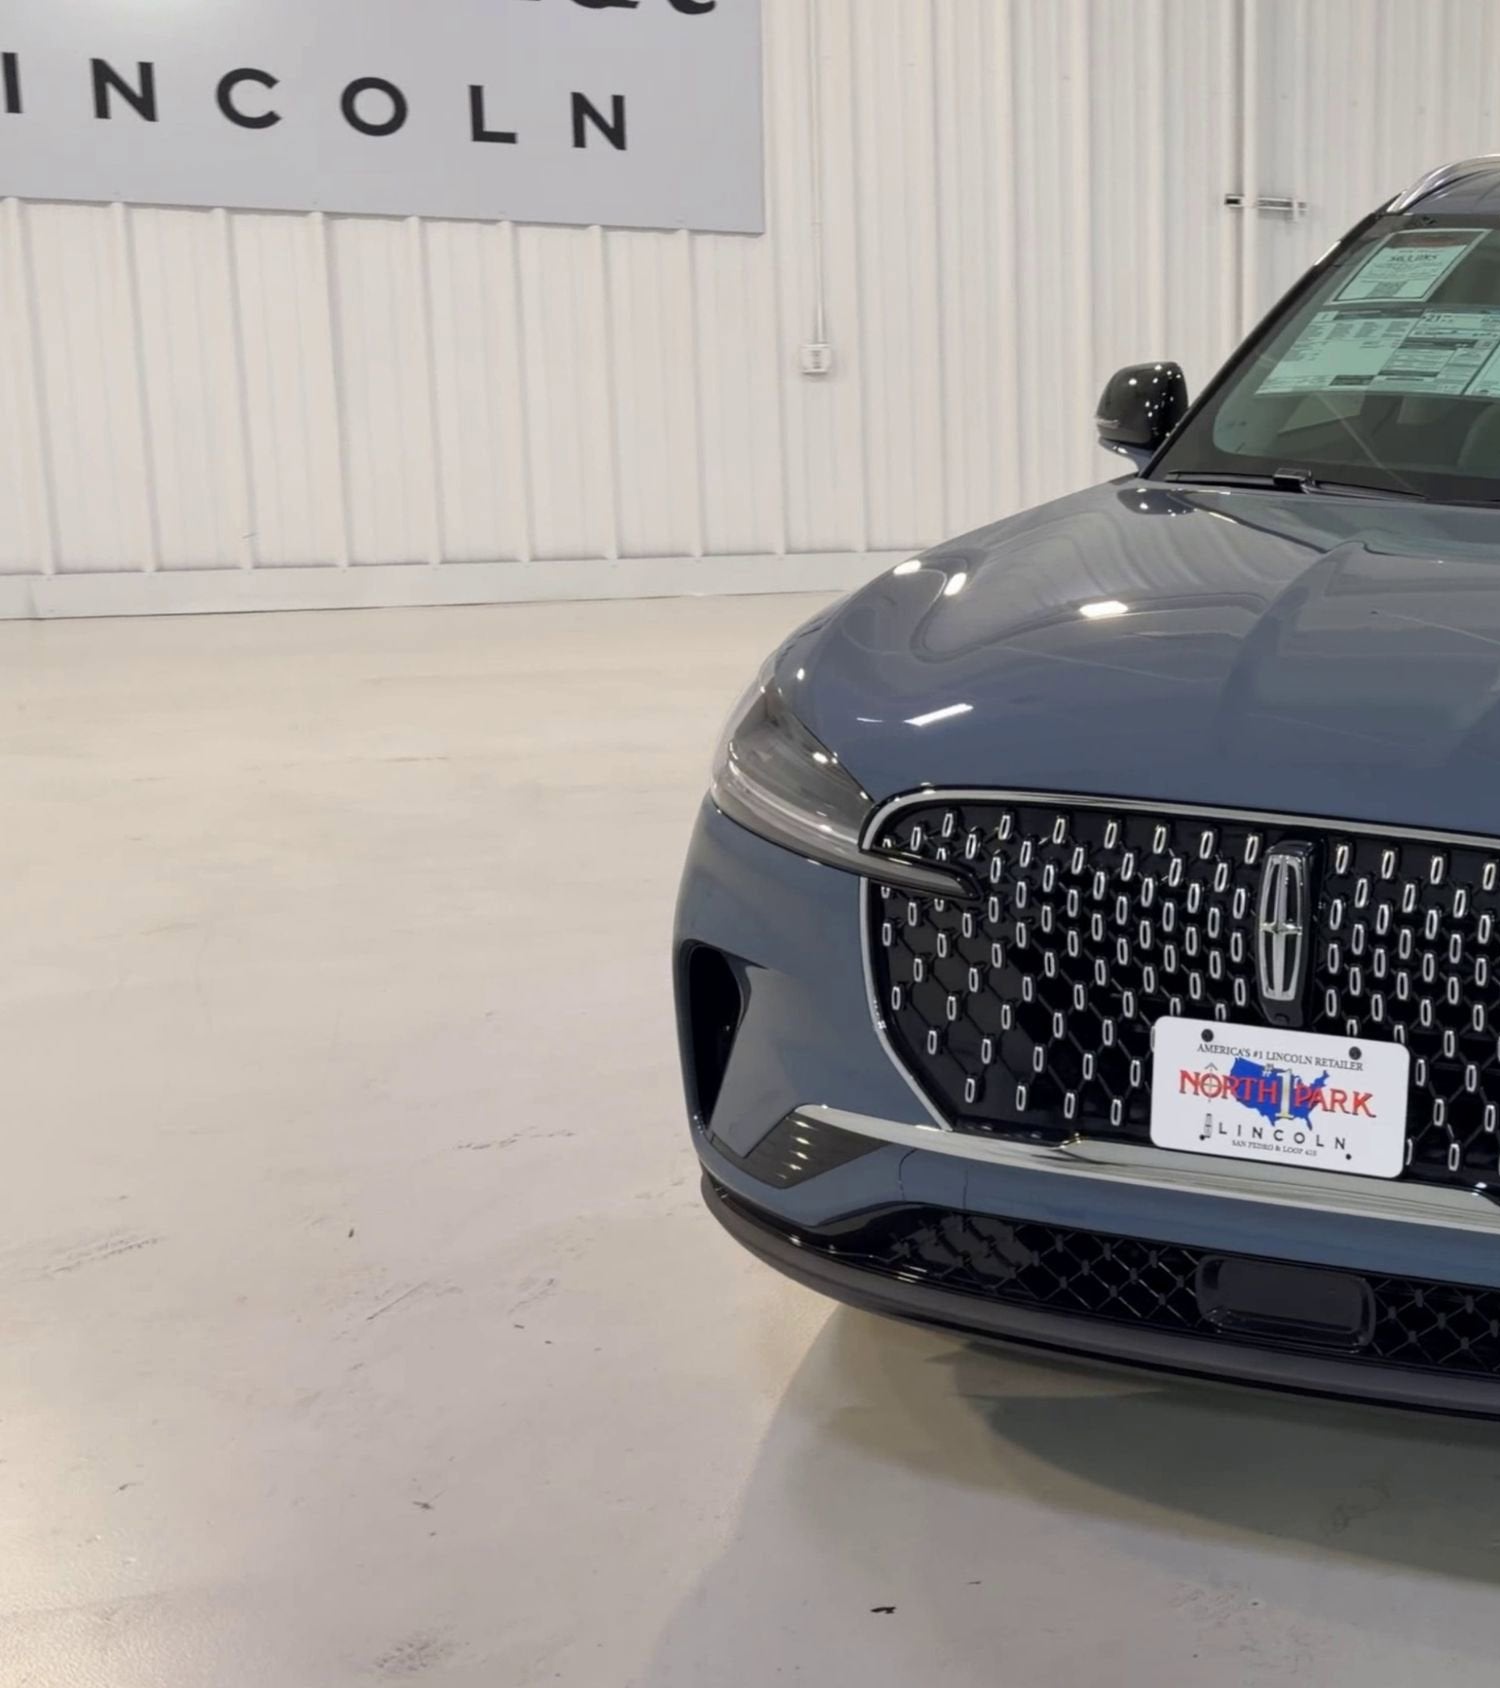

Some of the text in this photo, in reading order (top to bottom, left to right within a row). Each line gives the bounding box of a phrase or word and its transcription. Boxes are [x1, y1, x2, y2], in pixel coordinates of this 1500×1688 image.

[1197, 1043, 1364, 1071] AMERICA'S #1 LINCOLN RETAILER
[1178, 1069, 1377, 1119] NORTH PARK
[1218, 1122, 1346, 1150] LINCOLN
